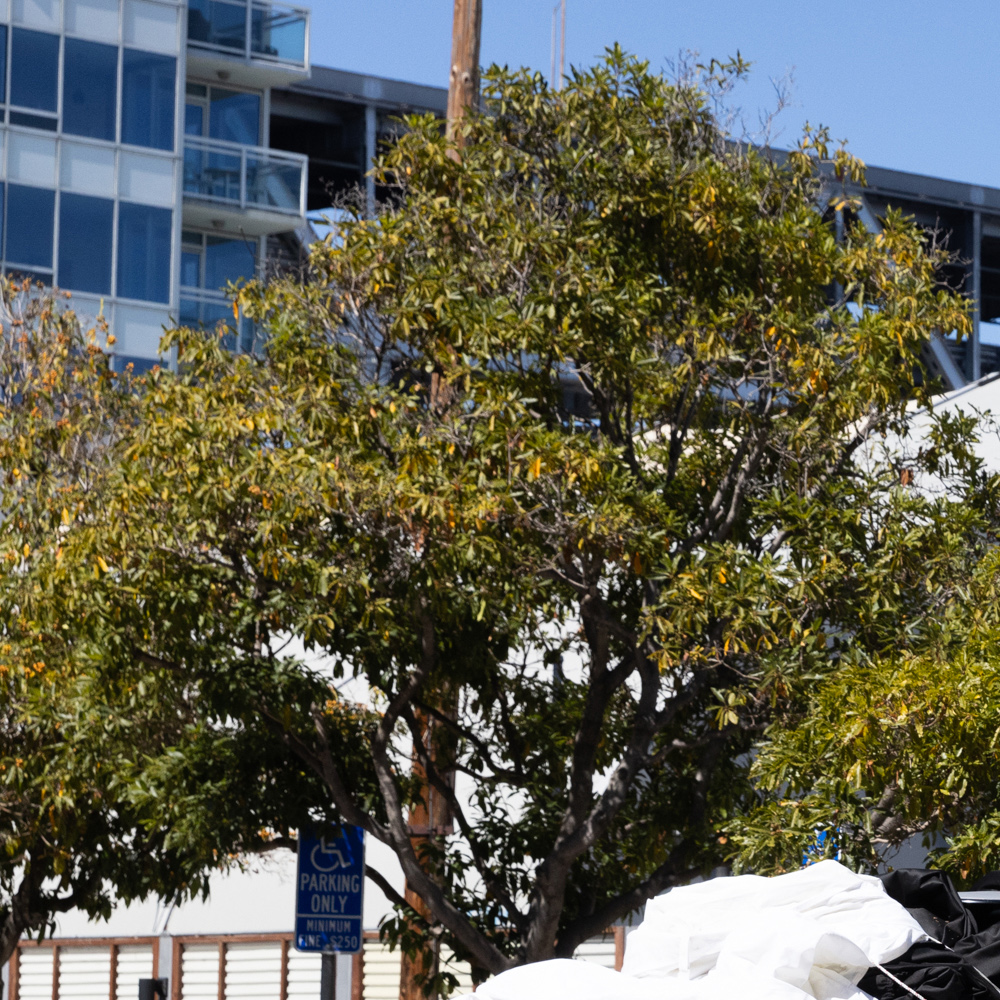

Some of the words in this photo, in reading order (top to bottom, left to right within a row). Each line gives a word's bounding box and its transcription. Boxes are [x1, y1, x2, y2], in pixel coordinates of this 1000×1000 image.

[300, 873, 360, 893] PARKING
[311, 894, 348, 914] ONLY
[306, 919, 351, 933] MINIMUM
[329, 935, 358, 949] $250
